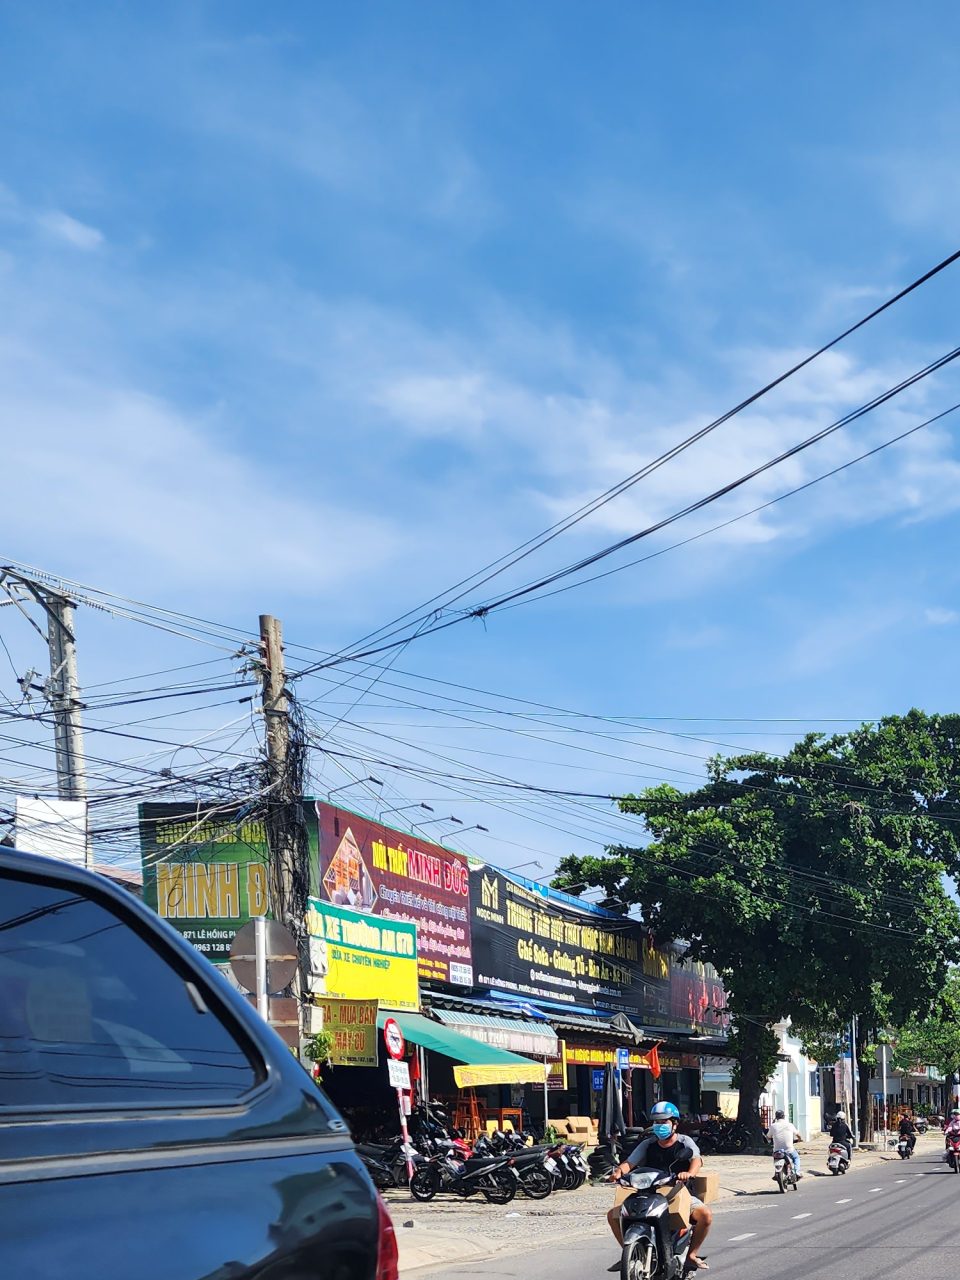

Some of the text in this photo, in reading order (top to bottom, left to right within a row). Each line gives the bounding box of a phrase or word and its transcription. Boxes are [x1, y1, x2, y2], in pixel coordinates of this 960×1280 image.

[407, 848, 441, 888] MINH
[444, 857, 469, 896] ĐỨC
[156, 862, 240, 918] MINH
[325, 915, 341, 941] XE
[506, 899, 533, 934] TRUNG
[518, 938, 533, 961] Ghế
[534, 942, 549, 967] Sofa
[340, 1005, 356, 1024] MUA
